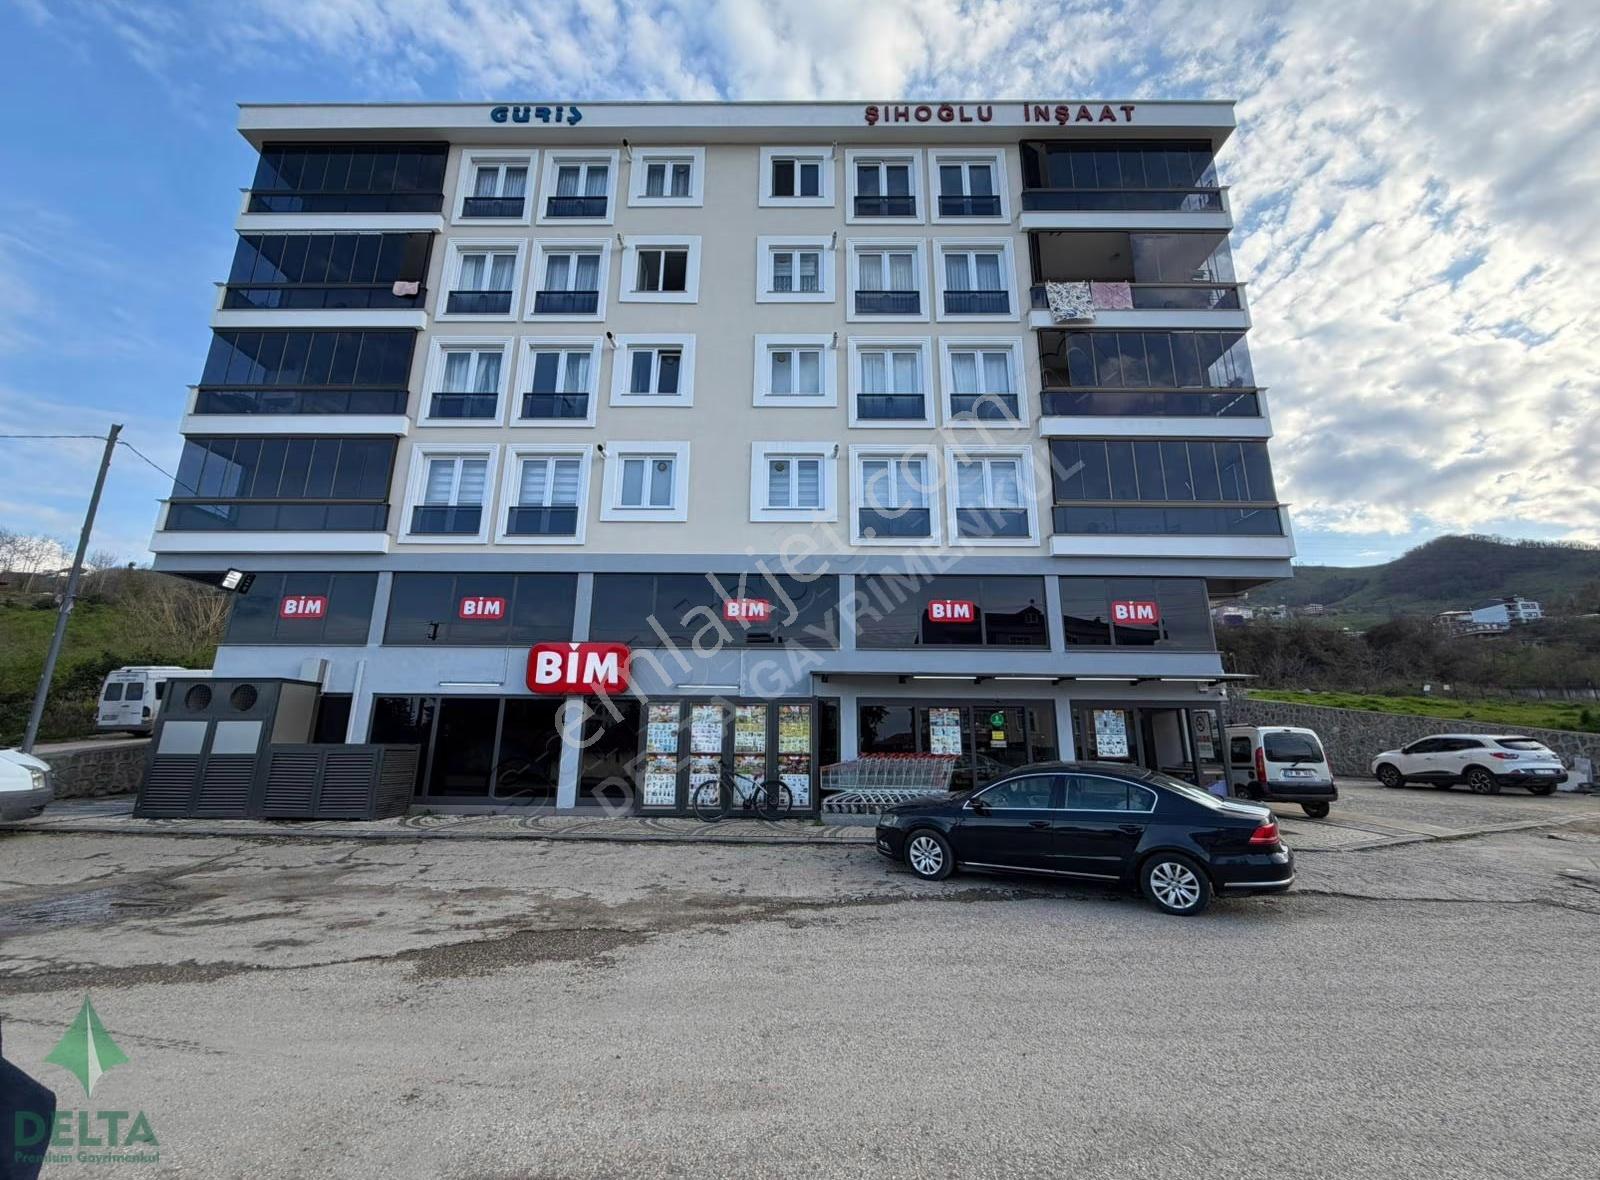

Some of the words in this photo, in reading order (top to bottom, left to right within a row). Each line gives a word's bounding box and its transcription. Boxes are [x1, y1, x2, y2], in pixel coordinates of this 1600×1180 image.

[1023, 101, 1136, 126] İNŞAAT
[283, 595, 322, 614] BİM
[463, 596, 500, 615] BİM
[727, 598, 765, 617] BİM
[932, 600, 970, 618] BİM
[1115, 601, 1154, 619] BİM
[535, 643, 619, 685] BİM
